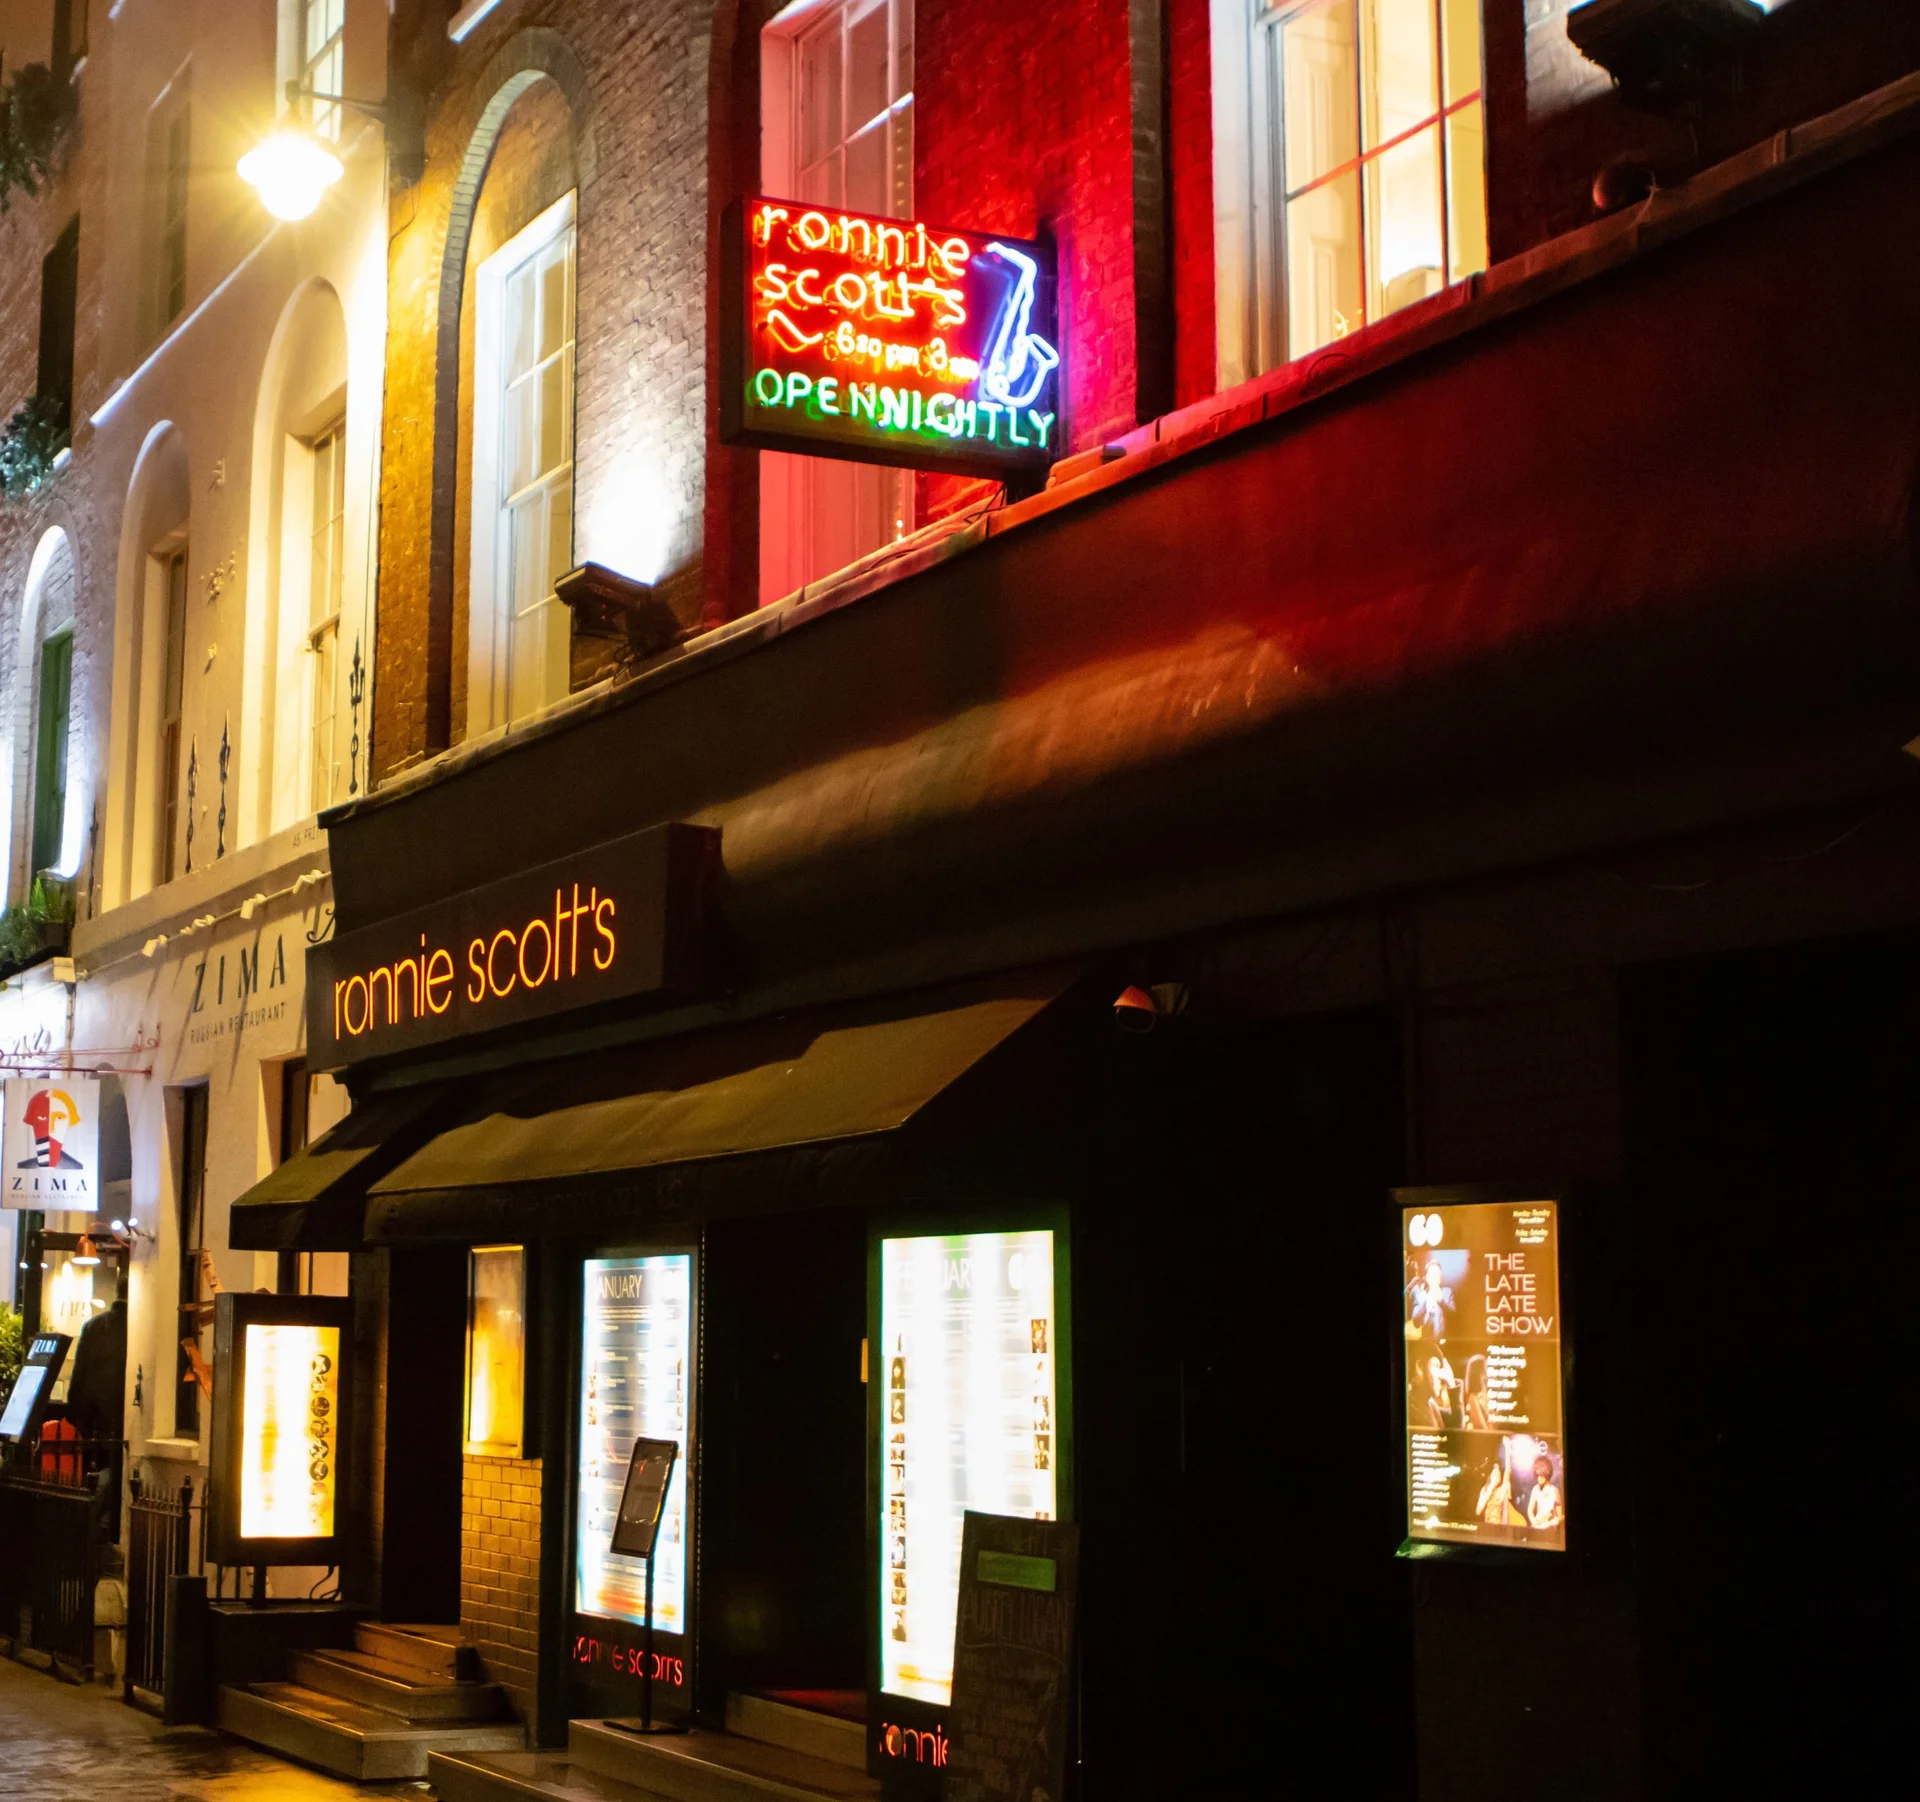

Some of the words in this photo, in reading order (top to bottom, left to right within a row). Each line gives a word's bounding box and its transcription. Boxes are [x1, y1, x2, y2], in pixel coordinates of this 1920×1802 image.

[761, 205, 970, 276] ronnie
[755, 367, 877, 419] OPEN
[879, 385, 1055, 447] NIGHTLY
[334, 932, 454, 1040] ronnie
[467, 883, 615, 1003] scott's
[191, 933, 285, 1014] ZIMA
[11, 1177, 87, 1191] ZIMA
[1484, 1252, 1525, 1271] THE
[594, 1274, 643, 1299] ANUARY
[1485, 1274, 1536, 1292] LATE
[1485, 1295, 1537, 1313] LATE
[1485, 1316, 1553, 1334] SHOW
